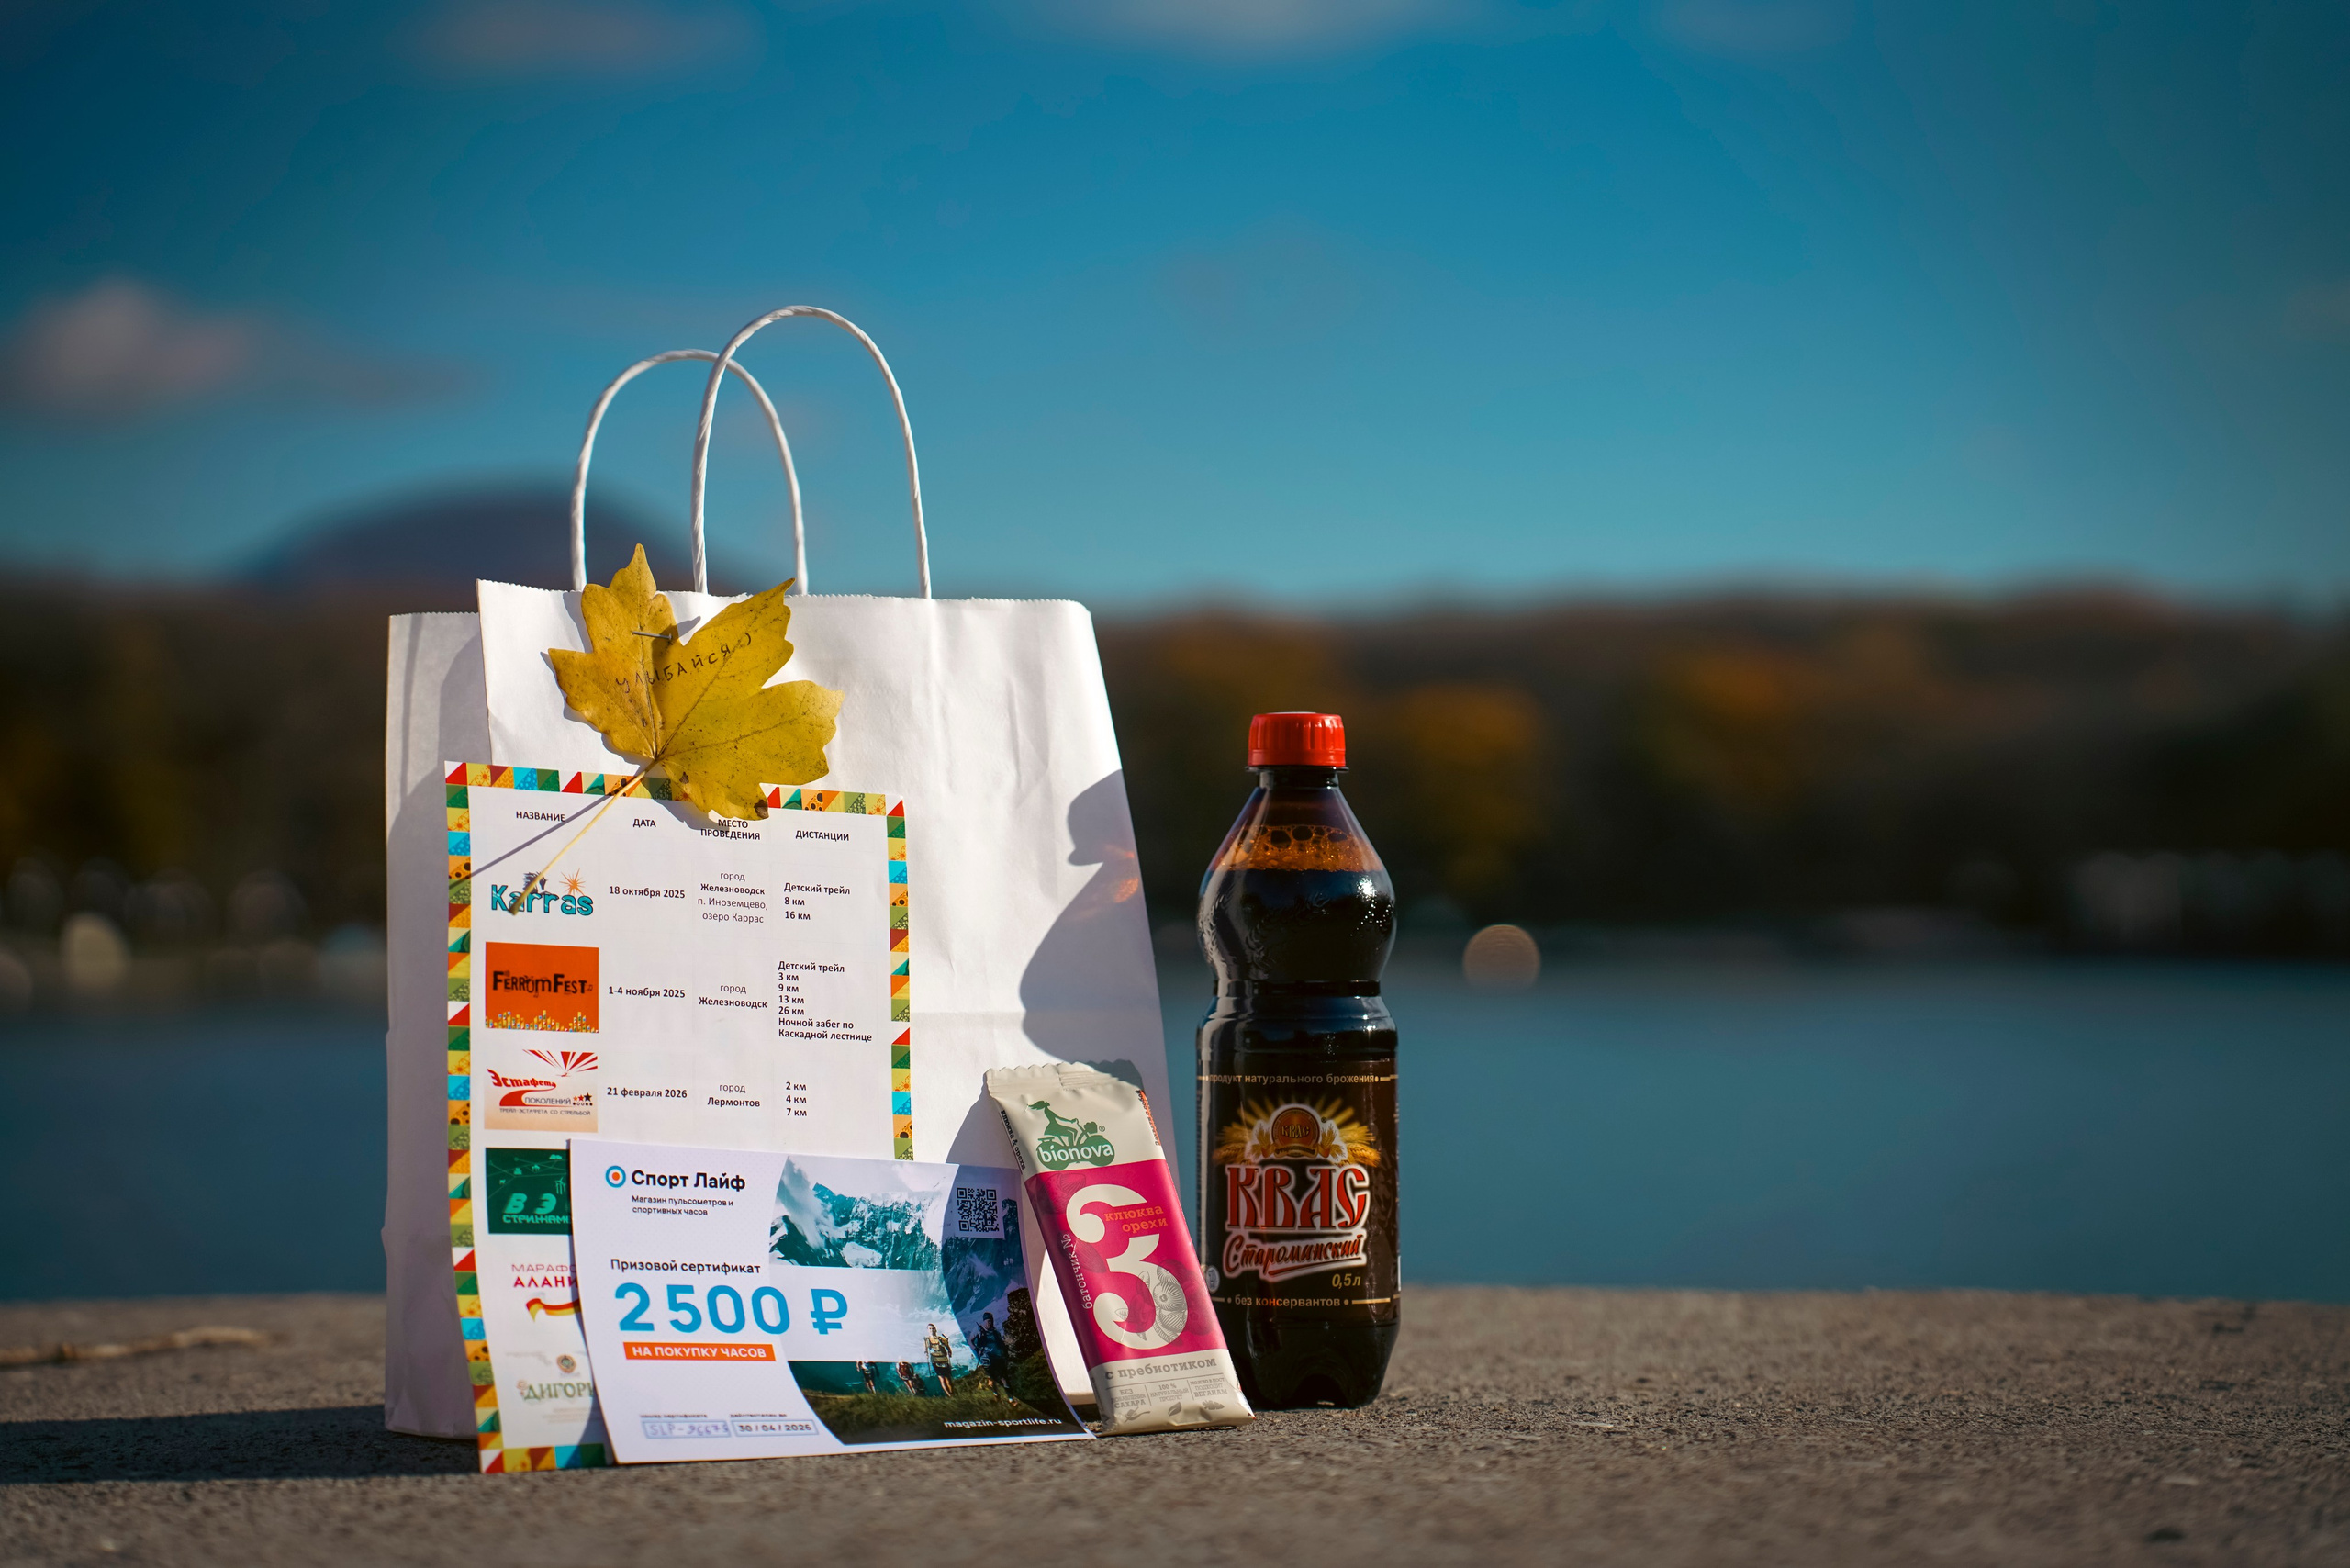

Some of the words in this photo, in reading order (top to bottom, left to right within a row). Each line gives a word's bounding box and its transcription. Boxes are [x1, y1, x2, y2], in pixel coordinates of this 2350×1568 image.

[516, 811, 565, 822] НАЗВАНИЕ
[632, 818, 656, 827] ДАТА
[718, 819, 748, 828] МЕСТО
[700, 828, 760, 840] ПРОВЕДЕНИЯ
[795, 830, 849, 842] ДИСТАНЦИИ
[720, 872, 745, 882] город
[610, 886, 621, 894] 18
[622, 887, 661, 898] октября
[664, 889, 686, 899] 2025
[700, 883, 765, 896] Железноводск
[784, 883, 822, 894] Детский
[824, 886, 850, 895] трейл
[708, 897, 768, 910] Иноземцево,
[784, 896, 789, 905] 8
[702, 913, 730, 923] озеро
[732, 913, 764, 924] Каррас
[785, 911, 795, 919] 16
[778, 960, 816, 971] Детский
[819, 964, 845, 973] трейл
[778, 973, 784, 981] 3
[608, 986, 623, 995] 1-4
[625, 988, 660, 998] ноября
[663, 989, 685, 998] 2025
[720, 984, 746, 994] город
[778, 984, 784, 992] 9
[699, 996, 767, 1009] Железноводск
[778, 995, 789, 1003] 13
[778, 1006, 789, 1015] 26
[778, 1017, 813, 1028] Ночной
[815, 1019, 840, 1029] забег
[778, 1029, 828, 1040] Каскадной
[830, 1033, 872, 1042] лестнице
[1209, 1074, 1242, 1084] продукт
[1245, 1074, 1323, 1085] натурального
[1326, 1073, 1374, 1085] брожения
[719, 1084, 746, 1094] город
[786, 1081, 791, 1091] 2
[607, 1087, 618, 1095] 21
[621, 1088, 662, 1099] февраля
[665, 1089, 688, 1098] 2026
[786, 1094, 791, 1103] 4
[524, 1096, 571, 1105] ПОКОЛЕНИЙ
[707, 1097, 760, 1108] Лермонтов
[786, 1107, 791, 1116] 7
[1281, 1124, 1310, 1138] КВАС
[1037, 1143, 1114, 1163] bionova
[632, 1170, 688, 1189] Спорт
[694, 1172, 746, 1192] Лайф
[632, 1195, 667, 1205] Магазин
[668, 1197, 727, 1208] пульсометров
[1227, 1167, 1368, 1230] КВАС
[632, 1206, 682, 1216] спортивных
[1104, 1205, 1164, 1222] клюква
[1122, 1217, 1168, 1234] орехи
[1224, 1234, 1363, 1275] Староминский
[610, 1258, 677, 1272] Призовой
[680, 1260, 761, 1274] сертификат
[1066, 1183, 1188, 1350] 3
[1069, 1250, 1093, 1309] батончик
[1332, 1273, 1351, 1289] 0,5
[1352, 1276, 1361, 1286] л
[1235, 1294, 1252, 1305] без
[1256, 1295, 1341, 1309] консервантов
[632, 1346, 653, 1356] НА
[655, 1347, 719, 1357] ПОКУПКУ
[721, 1348, 767, 1358] ЧАСОВ
[1105, 1371, 1113, 1380] с
[1117, 1358, 1217, 1379] пребиотиком
[1150, 1388, 1189, 1397] НАТУРАЛЬНЫЙ
[1193, 1389, 1228, 1398] ВЕГАНАМ
[1114, 1398, 1147, 1409] САХАРА
[944, 1418, 1063, 1429] magazin-sportlife.ru
